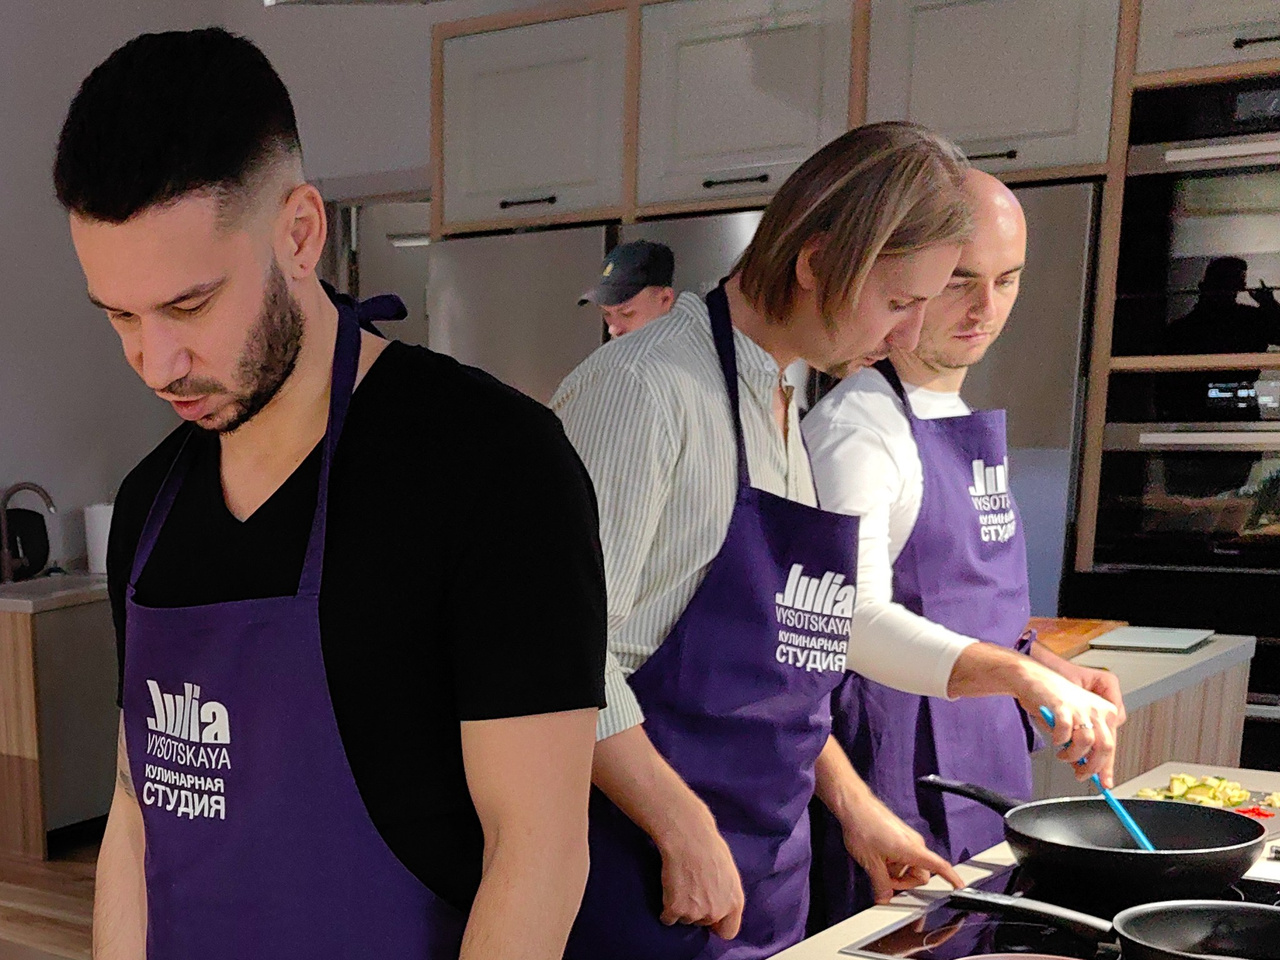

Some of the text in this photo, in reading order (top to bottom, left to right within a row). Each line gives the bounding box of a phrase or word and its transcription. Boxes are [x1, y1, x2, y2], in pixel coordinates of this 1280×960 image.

[775, 563, 856, 618] Julia
[775, 605, 852, 636] VYSOTSKAYA
[778, 629, 848, 654] КУЛИНАРНАЯ
[775, 644, 847, 674] СТУДИЯ
[146, 679, 231, 744] Julia
[146, 733, 231, 770] VYSOTSKAYA
[145, 763, 225, 793] КУЛИНАРНАЯ
[142, 781, 226, 820] СТУДИЯ
